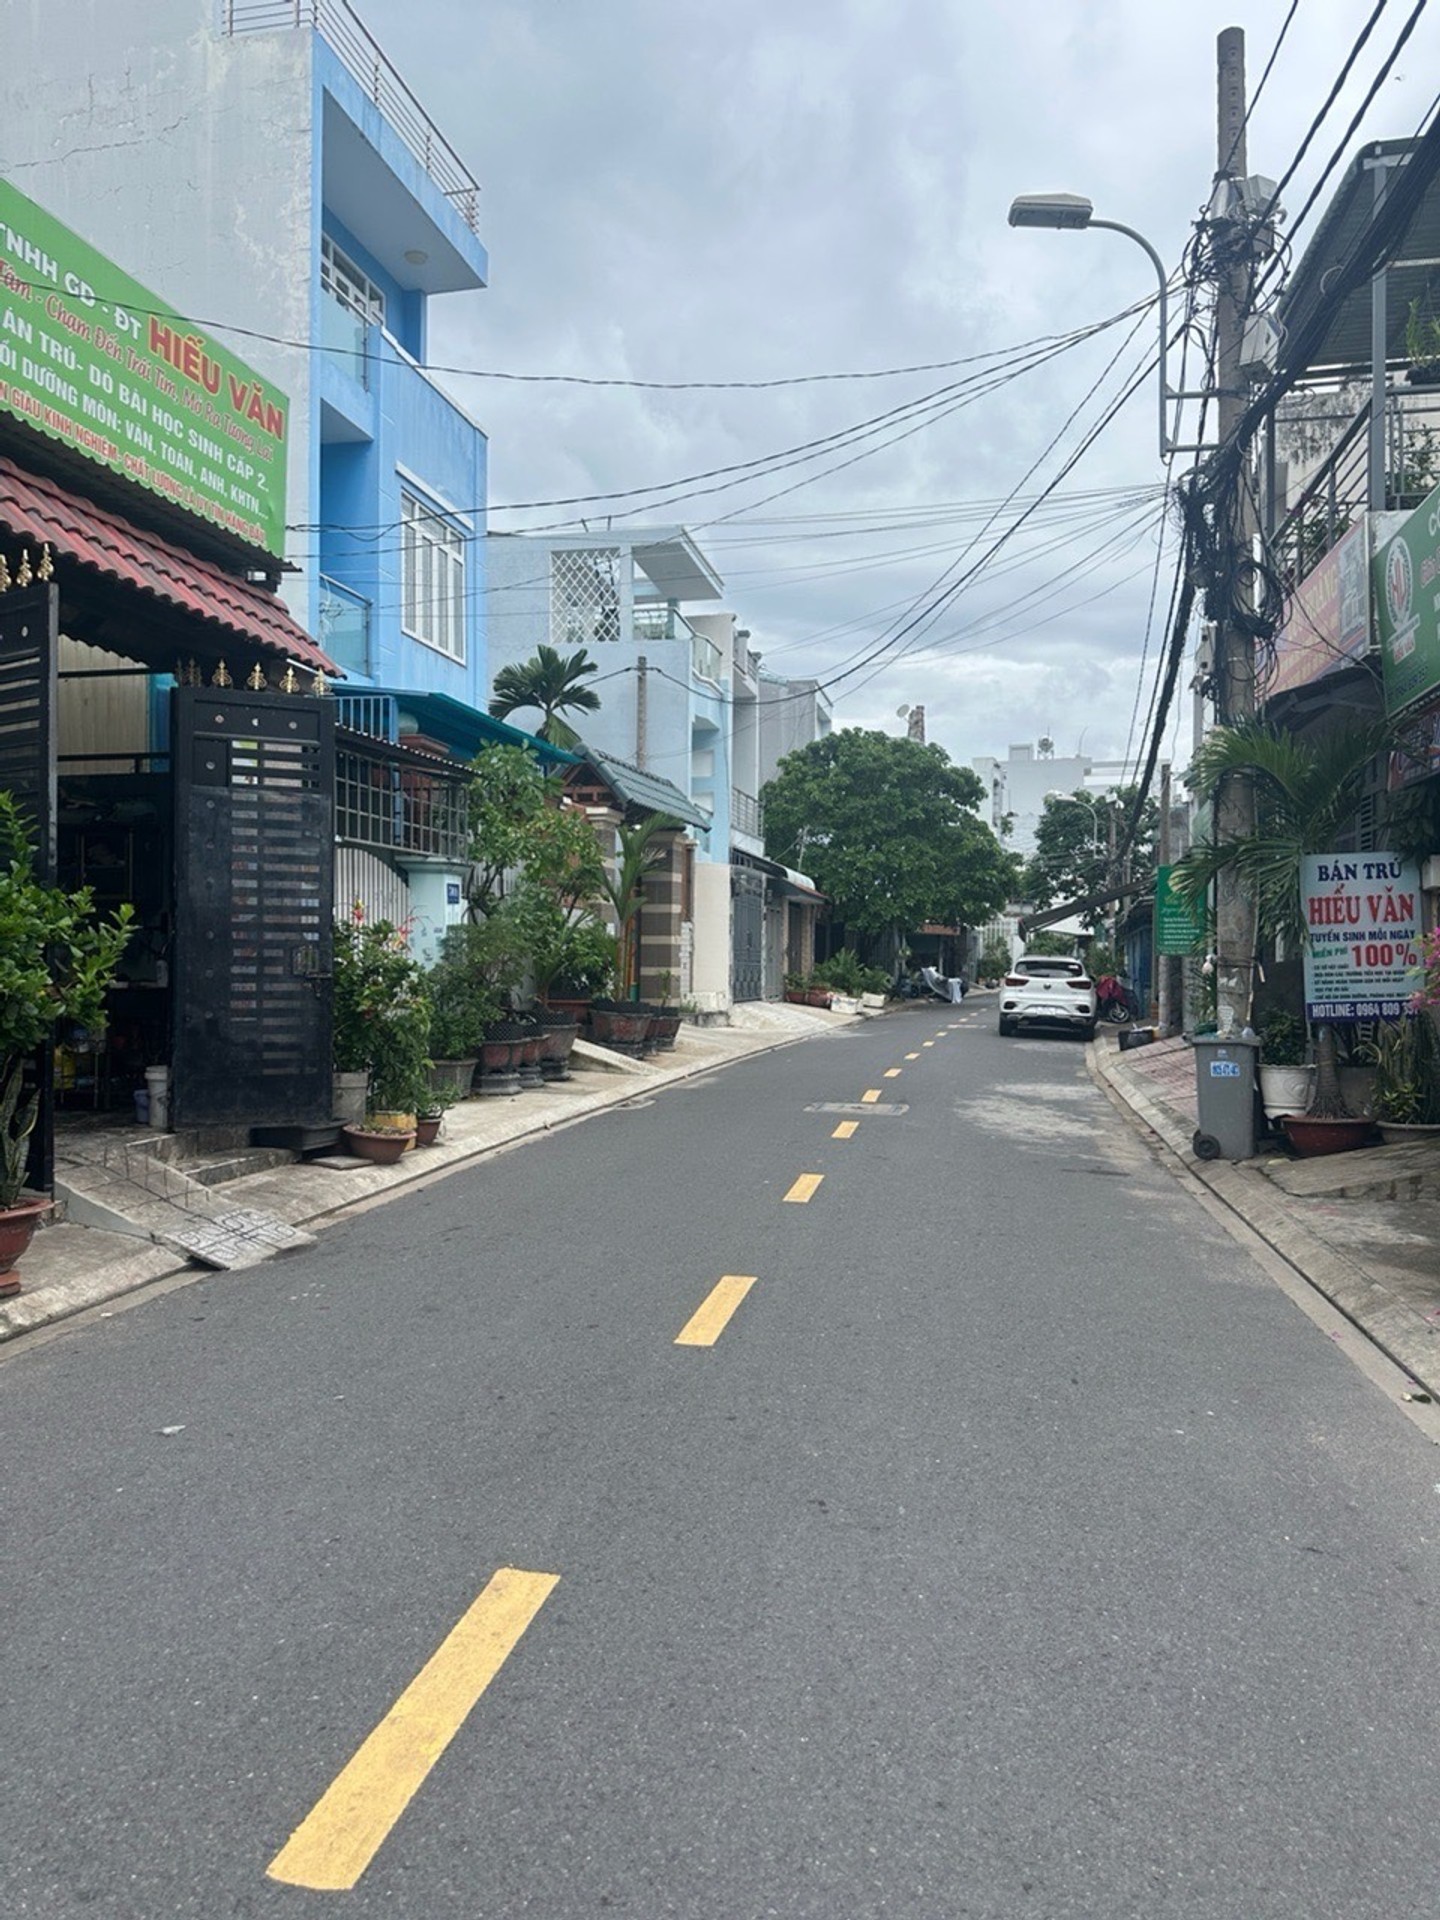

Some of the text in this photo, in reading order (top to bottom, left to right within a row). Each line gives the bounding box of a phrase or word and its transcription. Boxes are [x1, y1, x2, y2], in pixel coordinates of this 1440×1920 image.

[45, 294, 92, 343] Chạm
[22, 357, 78, 408] DƯỠNG
[149, 315, 222, 396] HIẾU
[227, 371, 284, 442] VĂN
[43, 403, 74, 439] KINH
[152, 405, 183, 439] HỌC
[188, 428, 223, 464] SINH
[1317, 857, 1402, 882] BÁN TRÚ
[1308, 883, 1414, 926] HIẾU VĂN
[1342, 930, 1366, 942] SINH
[1352, 943, 1417, 967] 100%
[1312, 1003, 1355, 1019] HOTLINE:
[1356, 1003, 1380, 1017] 0964
[1381, 1002, 1400, 1016] 809
